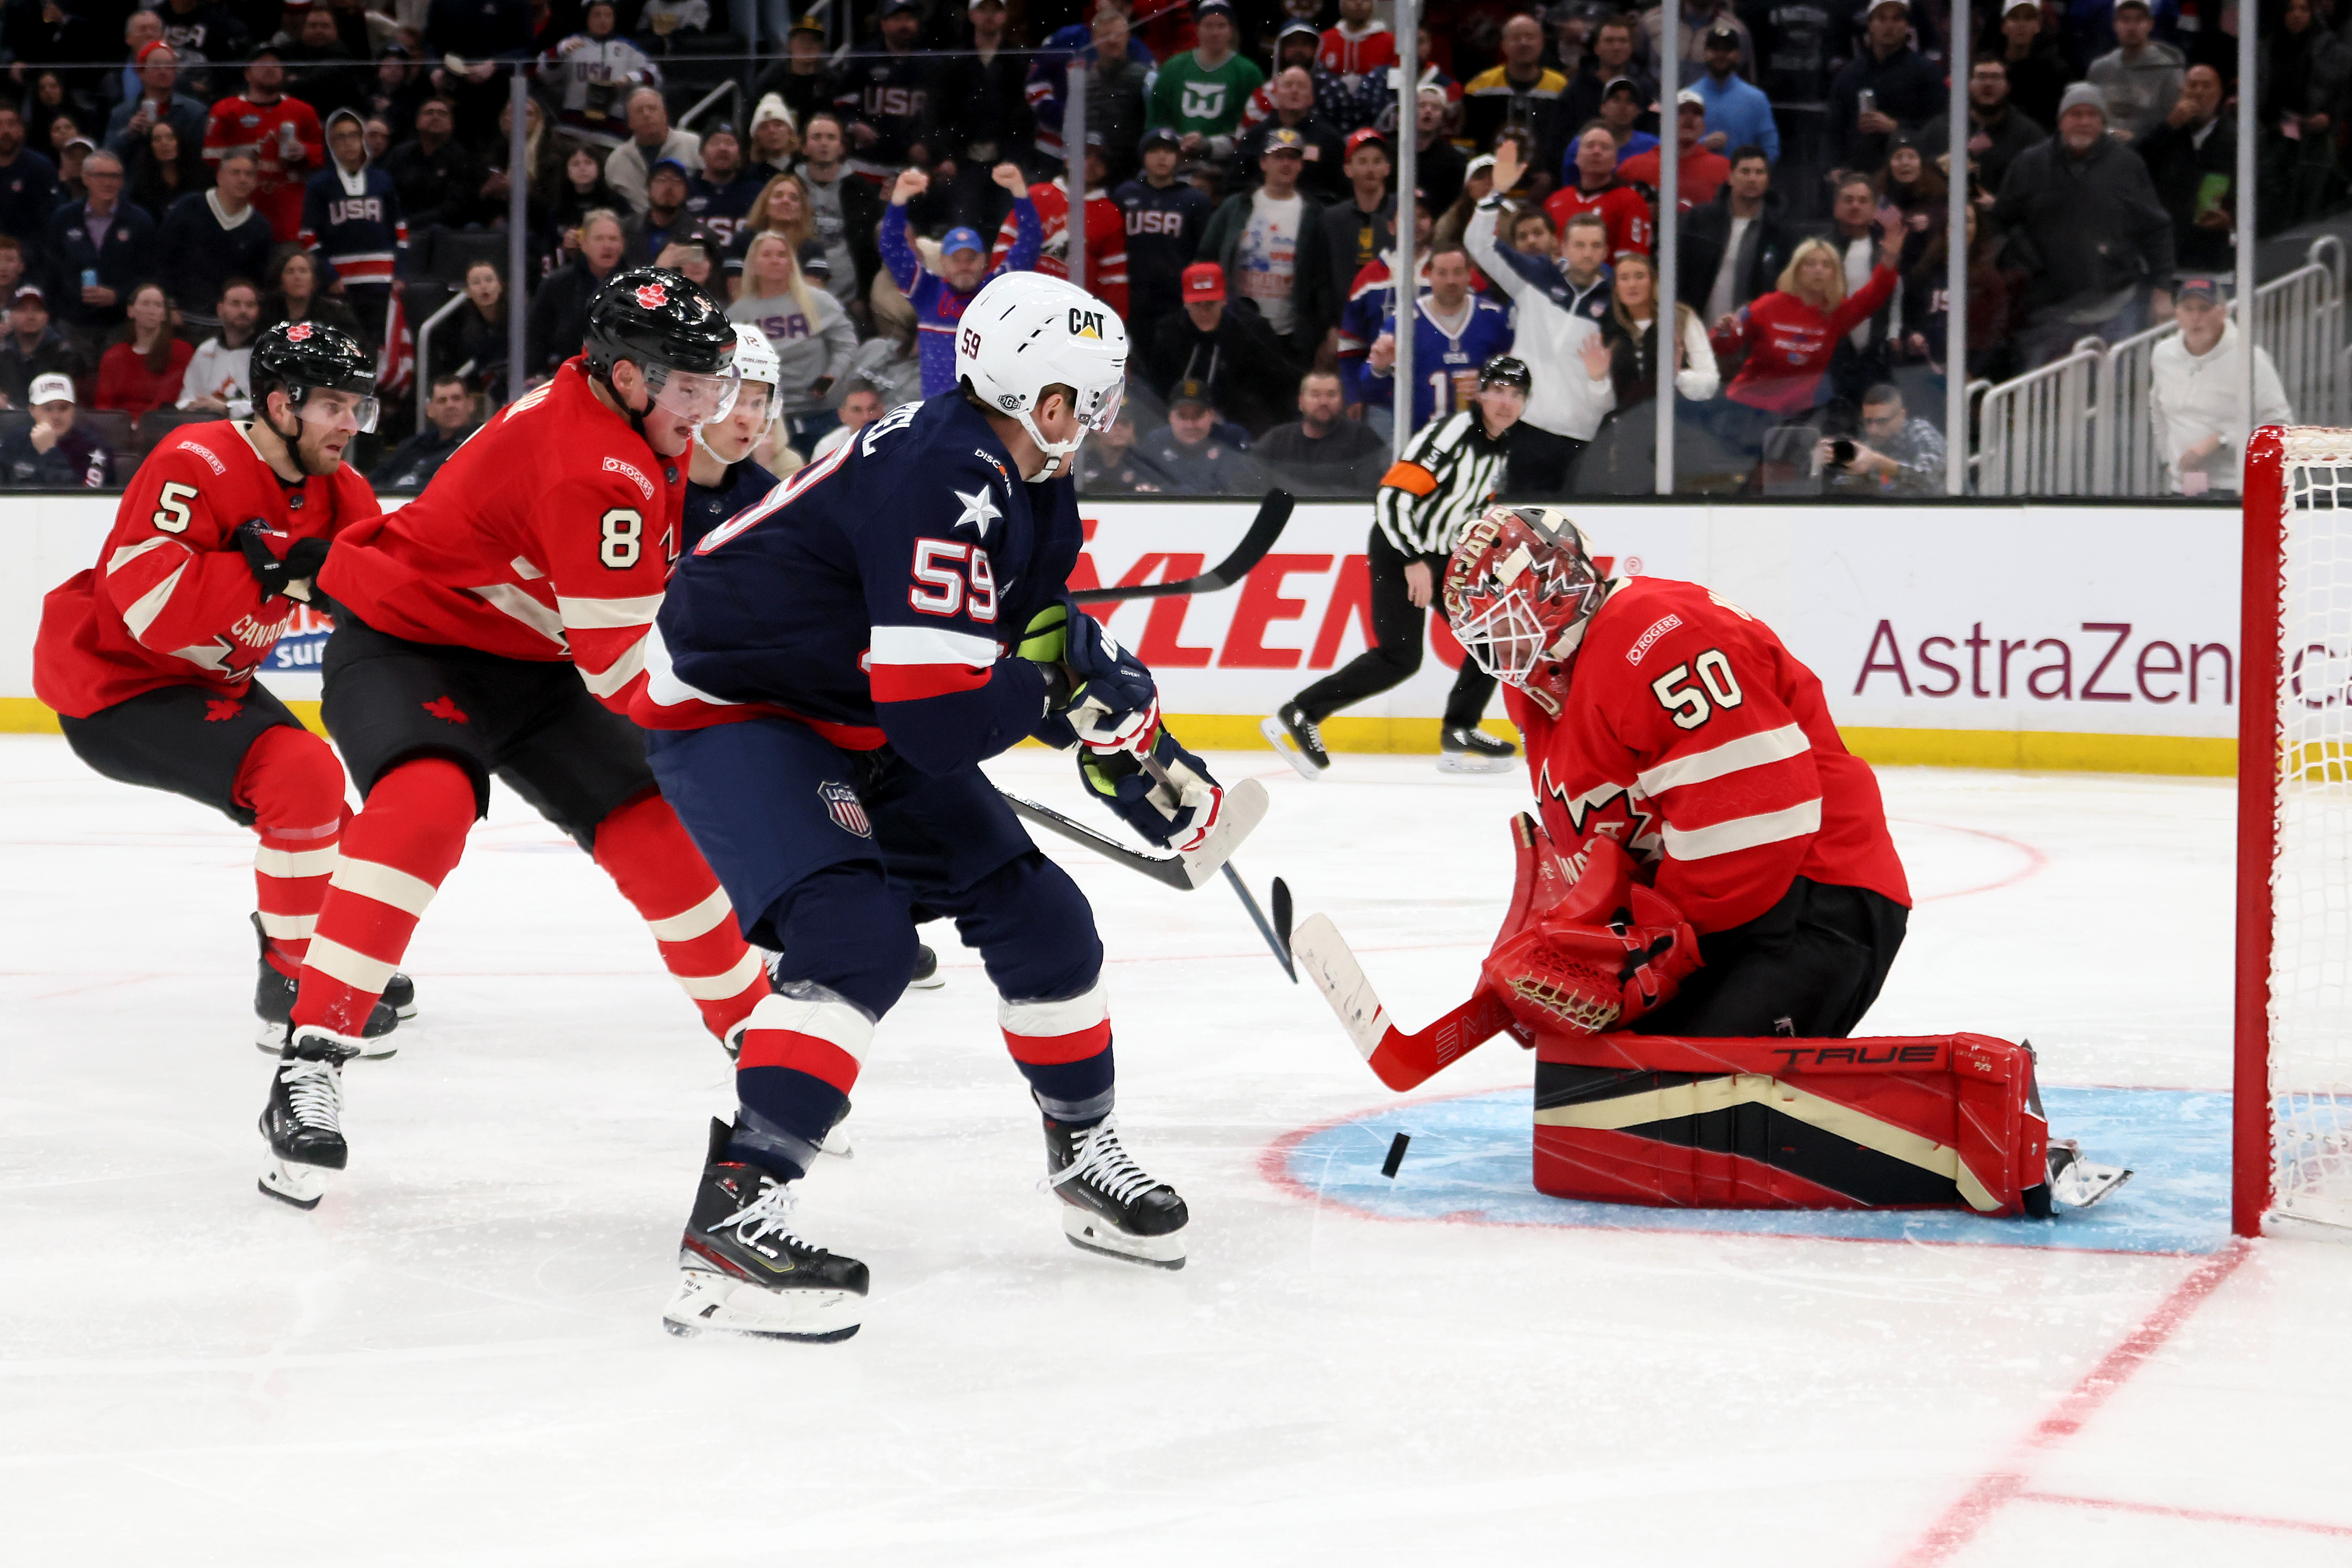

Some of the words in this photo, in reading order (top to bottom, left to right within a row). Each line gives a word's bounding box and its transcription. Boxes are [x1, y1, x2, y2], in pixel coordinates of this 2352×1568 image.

[864, 87, 926, 116] USA
[329, 198, 381, 226] USA
[1126, 210, 1183, 238] USA
[755, 314, 810, 340] SA
[1069, 307, 1104, 340] CAT
[961, 327, 981, 360] 59
[191, 443, 223, 472] ROGERS
[620, 464, 652, 496] ROGERS
[153, 481, 199, 534] 5
[600, 508, 643, 569] 8
[907, 536, 999, 625] 59
[1639, 618, 1678, 650] ROGERS
[1120, 669, 1140, 679] COVERT
[1650, 648, 1742, 731] 50
[826, 789, 857, 804] USA
[1772, 1046, 1939, 1065] TRUE
